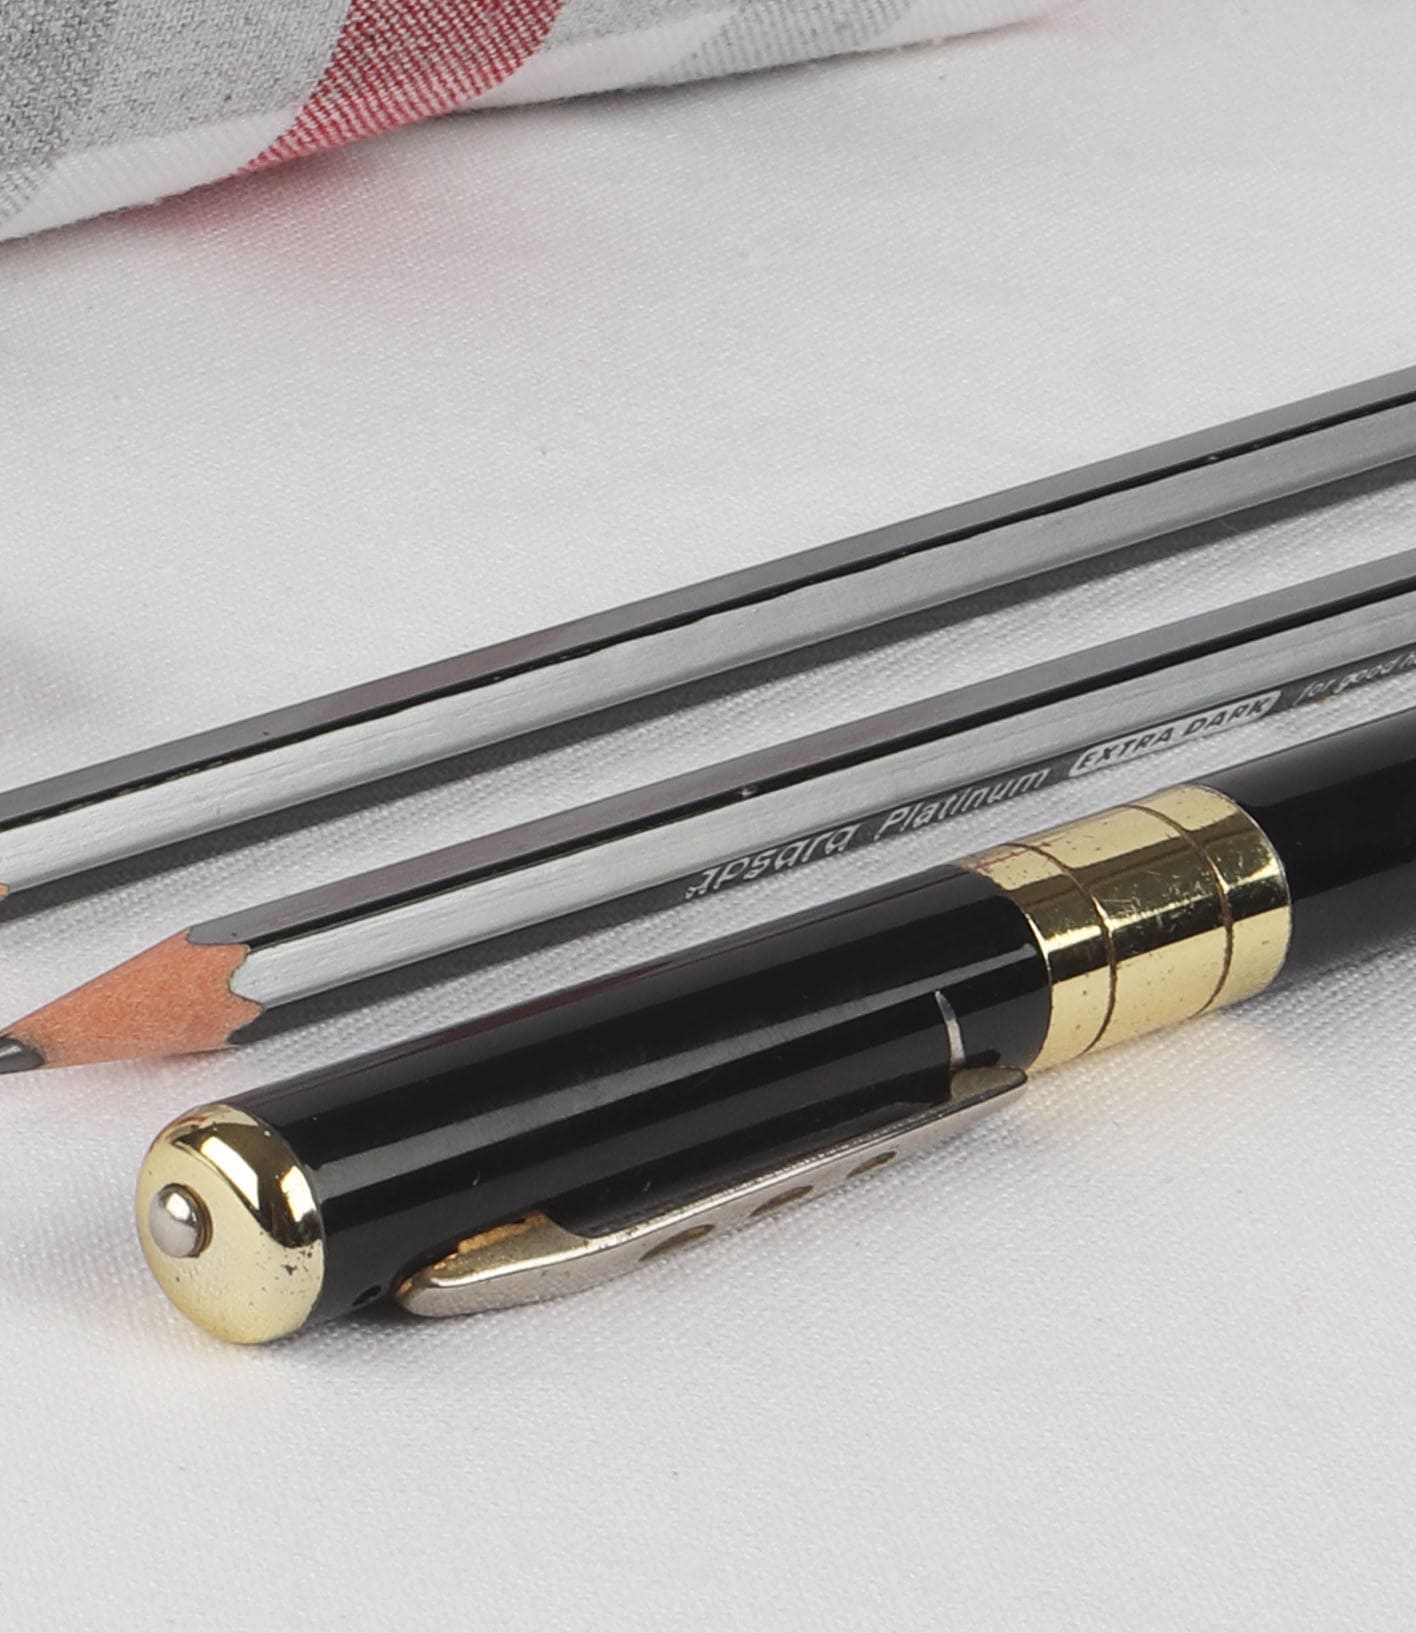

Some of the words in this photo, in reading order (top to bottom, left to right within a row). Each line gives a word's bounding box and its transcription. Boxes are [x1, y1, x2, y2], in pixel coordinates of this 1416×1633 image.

[874, 768, 1051, 841] Platinum
[1076, 727, 1174, 770] EXTRA
[1182, 697, 1272, 737] DARK
